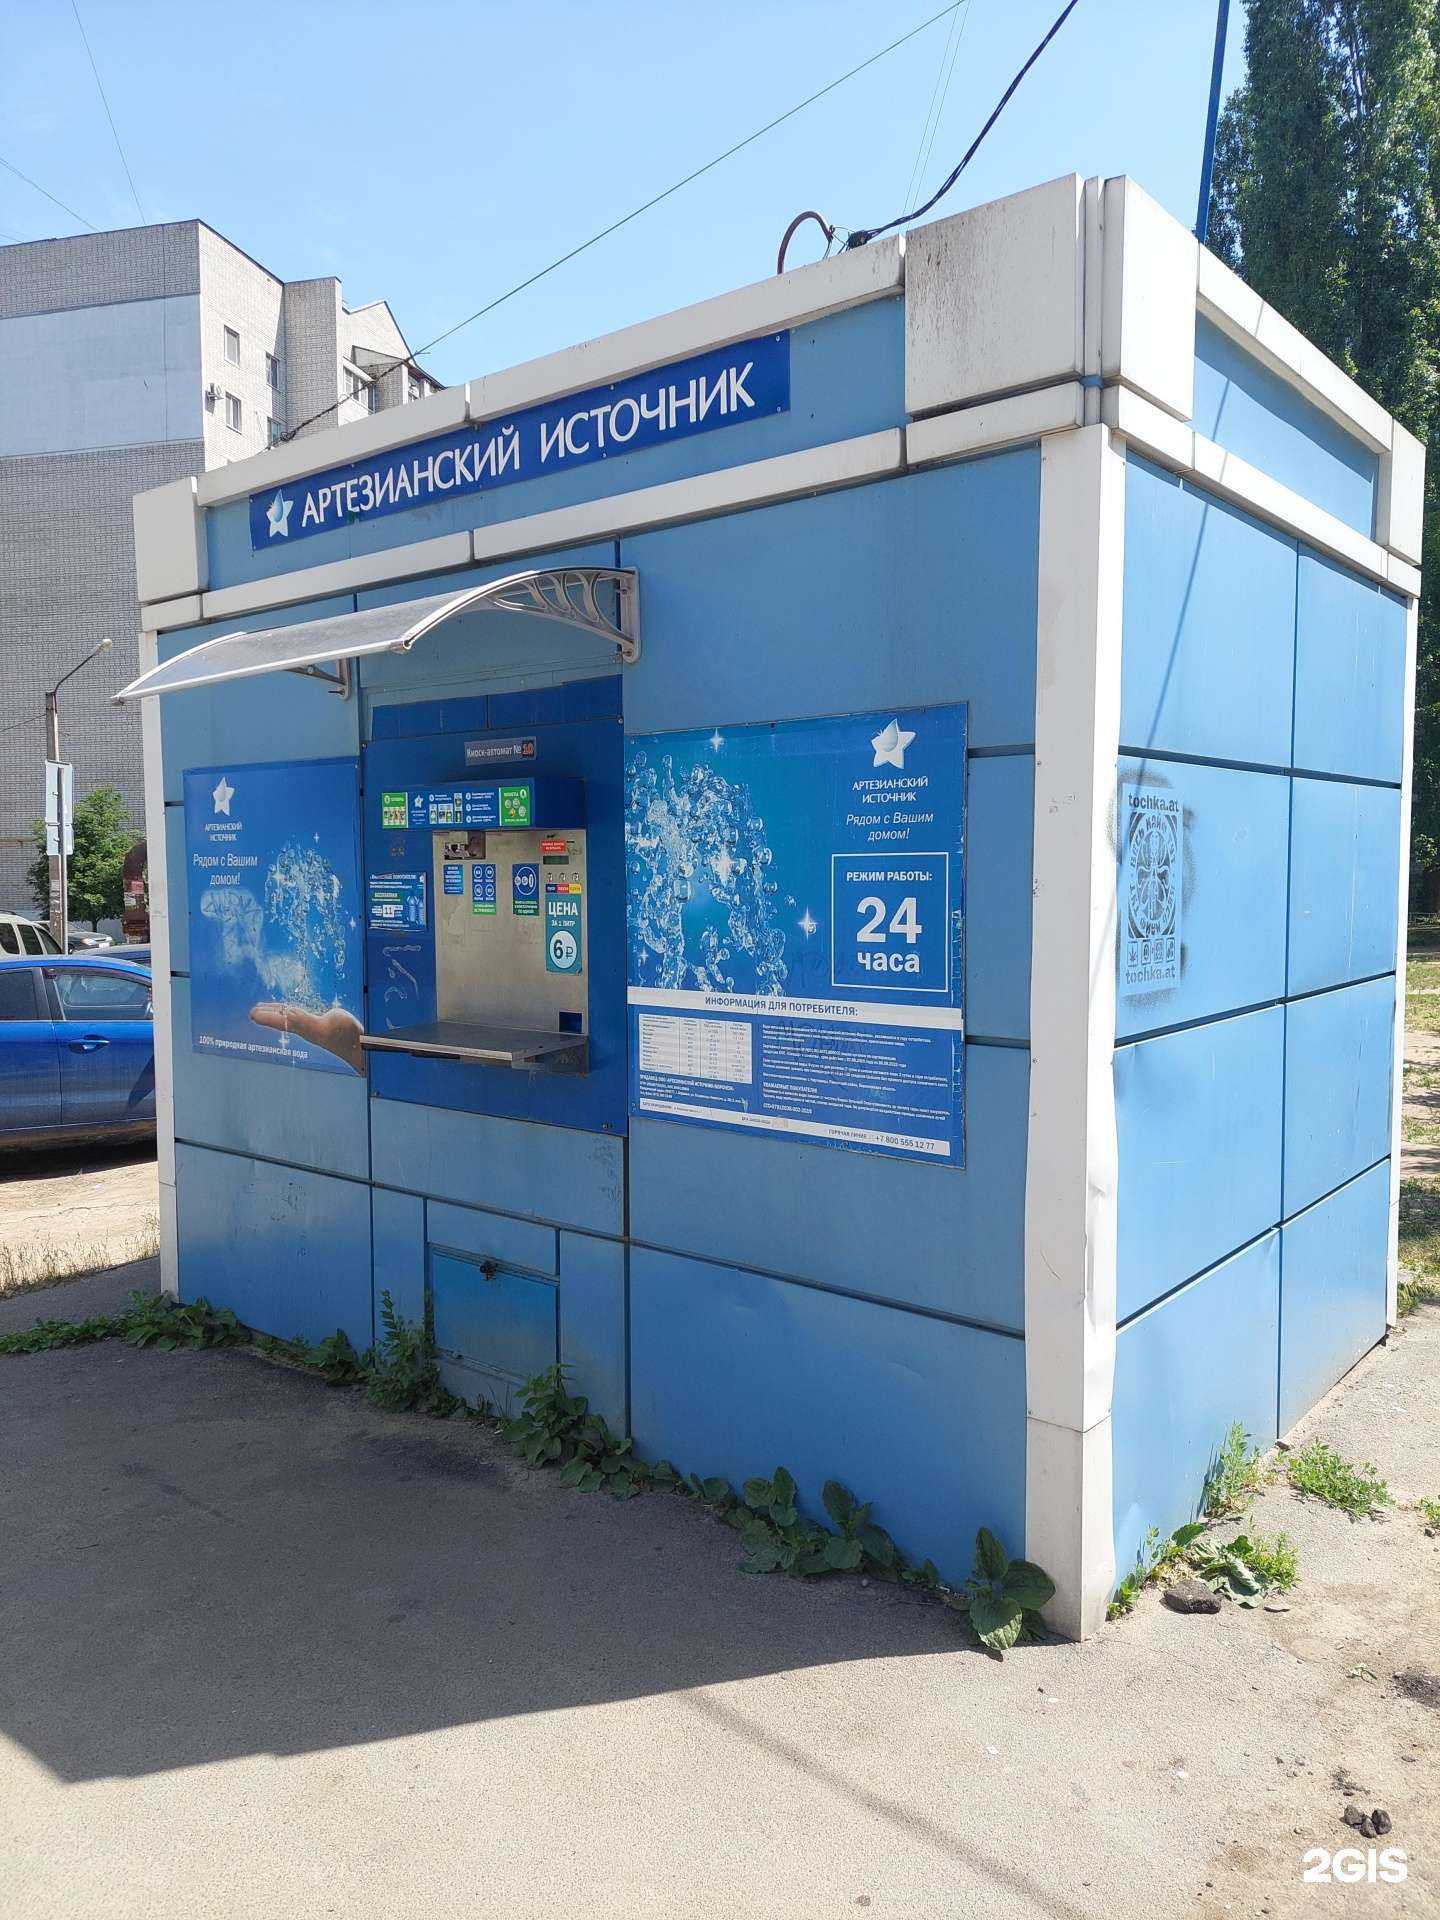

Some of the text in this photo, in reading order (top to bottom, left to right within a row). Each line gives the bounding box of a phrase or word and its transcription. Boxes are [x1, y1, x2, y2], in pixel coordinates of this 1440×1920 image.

[302, 361, 756, 528] АРТЕЗИАНСКИЙ ИСТОЧНИК
[853, 776, 928, 790] АРТЕЗИАНСКИЙ
[862, 791, 917, 803] ИСТОЧНИК
[1128, 794, 1179, 813] tochka.at
[204, 821, 242, 832] АРТЕЗИАНСКИЙ
[846, 811, 933, 827] Рядом с Вашим
[209, 832, 237, 842] ИСТОЧНИК
[867, 828, 910, 842] домом!
[193, 853, 219, 869] Рядом
[227, 852, 258, 867] Вашим
[209, 872, 241, 888] домом!
[846, 871, 933, 882] РЕЖИМ РАБОТЫ:
[548, 901, 579, 917] ЦЕНА
[551, 919, 558, 927] ЗА
[856, 896, 923, 945] 24
[857, 952, 920, 973] часа
[1125, 965, 1176, 985] tochka.at
[704, 996, 859, 1017] ИНФОРМАЦИЯ ДЛЯ ПОТРЕБИТЕЛЯ:
[215, 1038, 247, 1052] природная
[248, 1042, 291, 1057] артезианская
[292, 1048, 309, 1060] вода
[875, 1134, 885, 1143] +7
[885, 1135, 899, 1146] 800
[900, 1137, 914, 1148] 555
[914, 1139, 924, 1149] 12
[925, 1141, 935, 1151] 77
